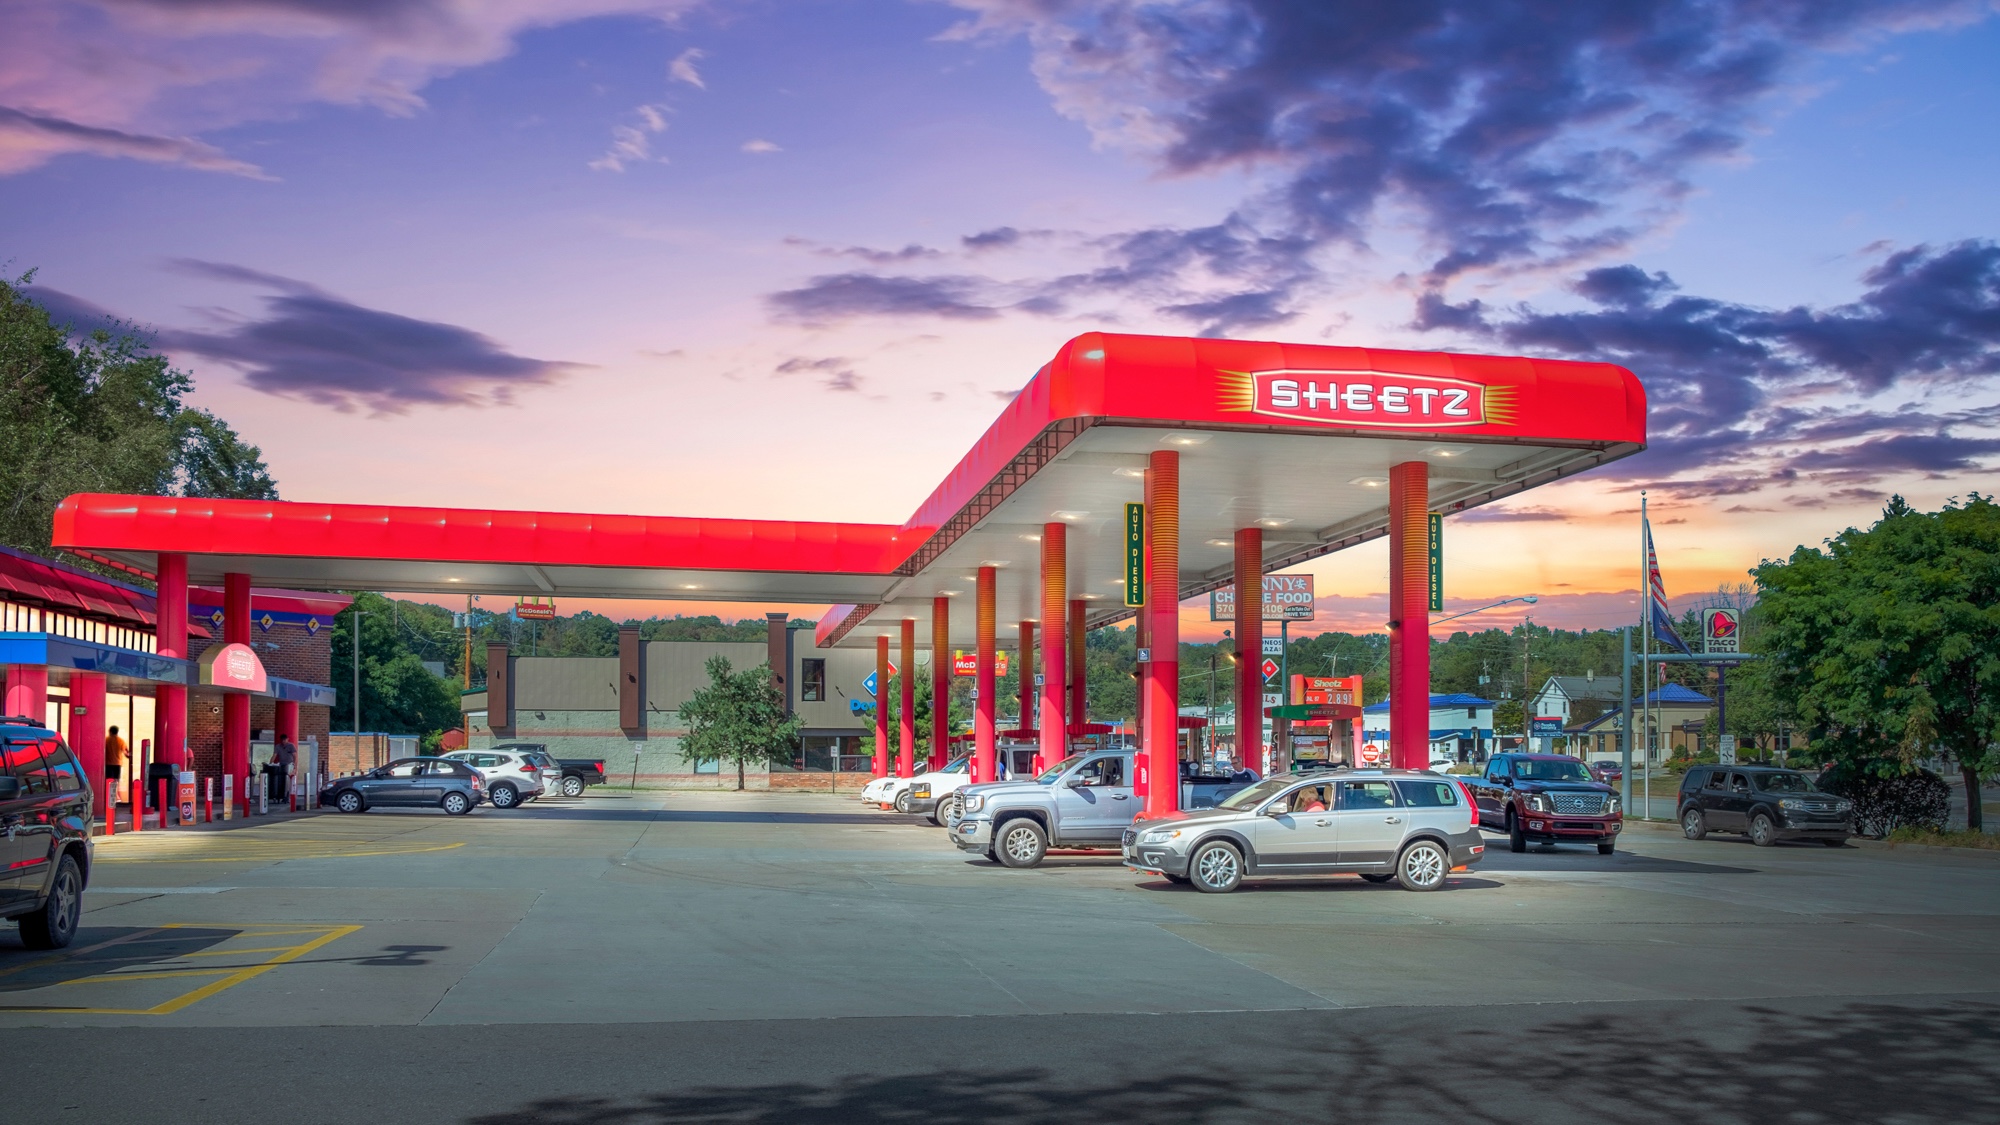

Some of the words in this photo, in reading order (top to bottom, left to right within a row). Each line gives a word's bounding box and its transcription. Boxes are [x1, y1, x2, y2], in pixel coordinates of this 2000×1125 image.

[1271, 379, 1470, 417] SHEETZ
[1275, 593, 1312, 603] FOOD
[231, 660, 251, 671] SHEETZ
[1313, 680, 1342, 688] Sheetz
